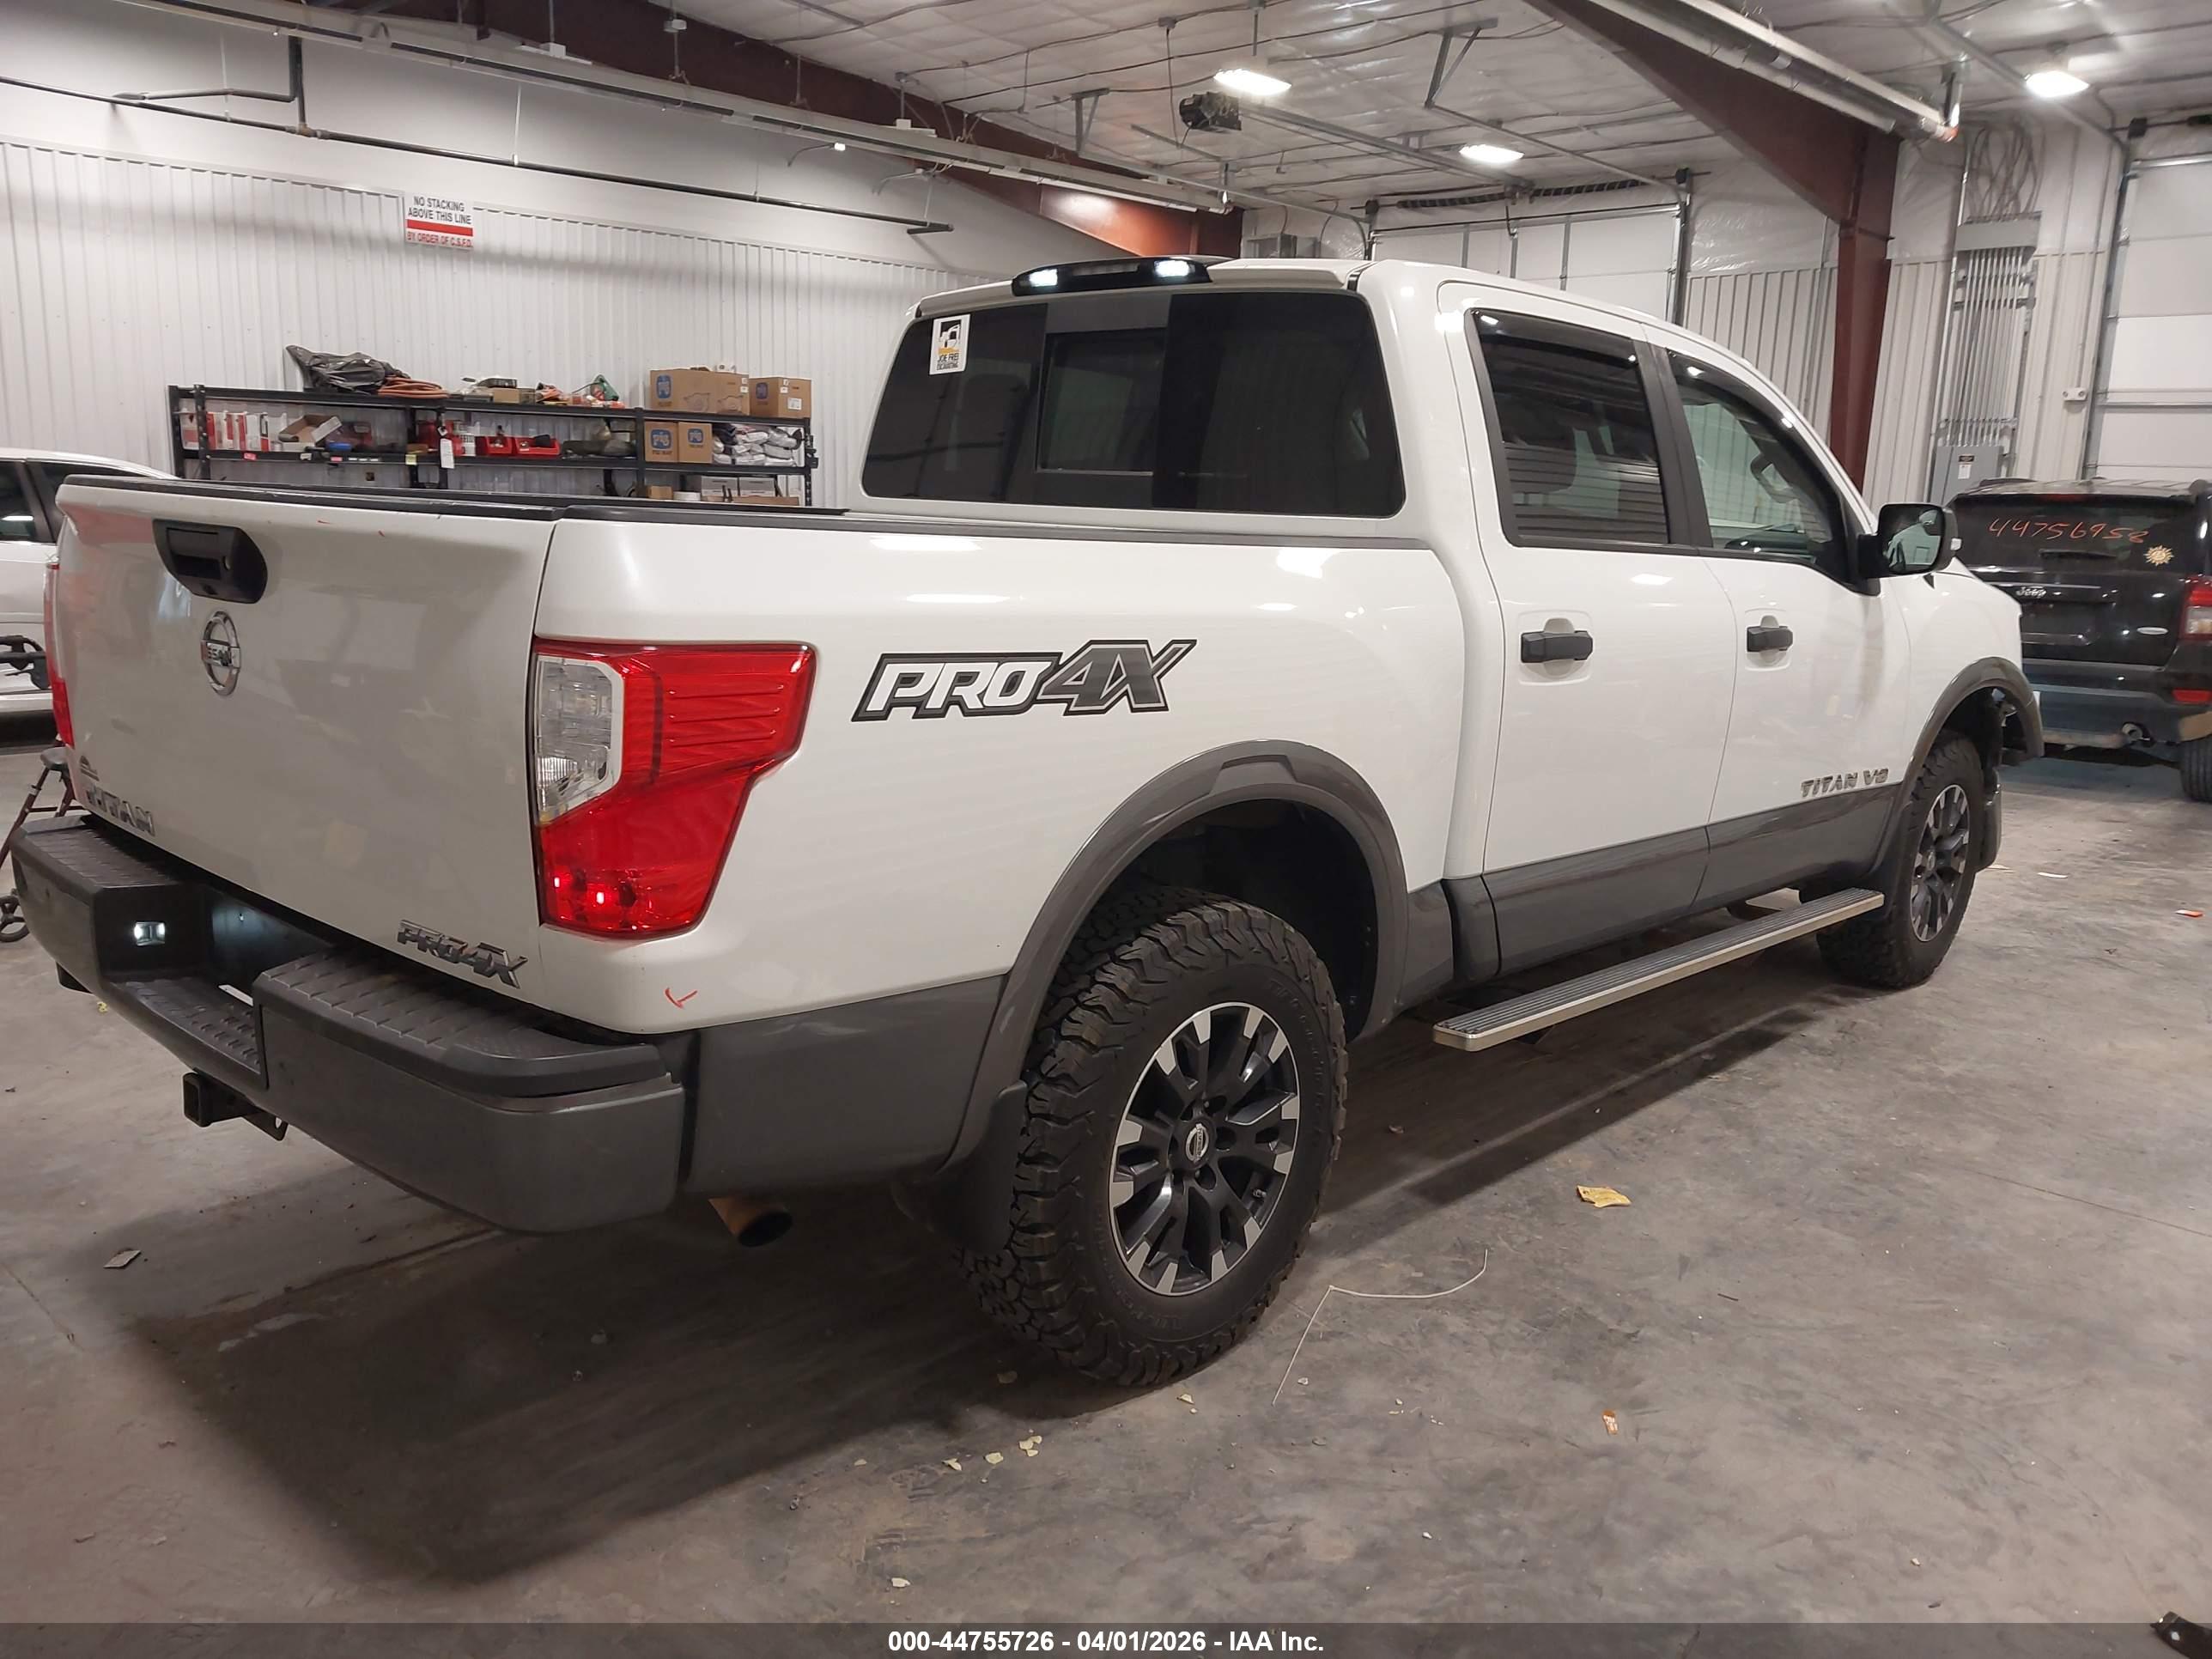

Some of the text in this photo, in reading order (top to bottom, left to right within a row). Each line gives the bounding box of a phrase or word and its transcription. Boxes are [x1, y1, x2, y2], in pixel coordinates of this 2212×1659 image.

[413, 196, 465, 212] NO STACKING
[408, 207, 471, 225] ABOVE THIS LINE
[406, 231, 416, 240] BY
[417, 233, 439, 244] ORDER
[441, 235, 449, 245] OF
[1989, 518, 2149, 544] 44756958
[2015, 586, 2047, 599] Jeep
[1801, 772, 1858, 798] TITAN
